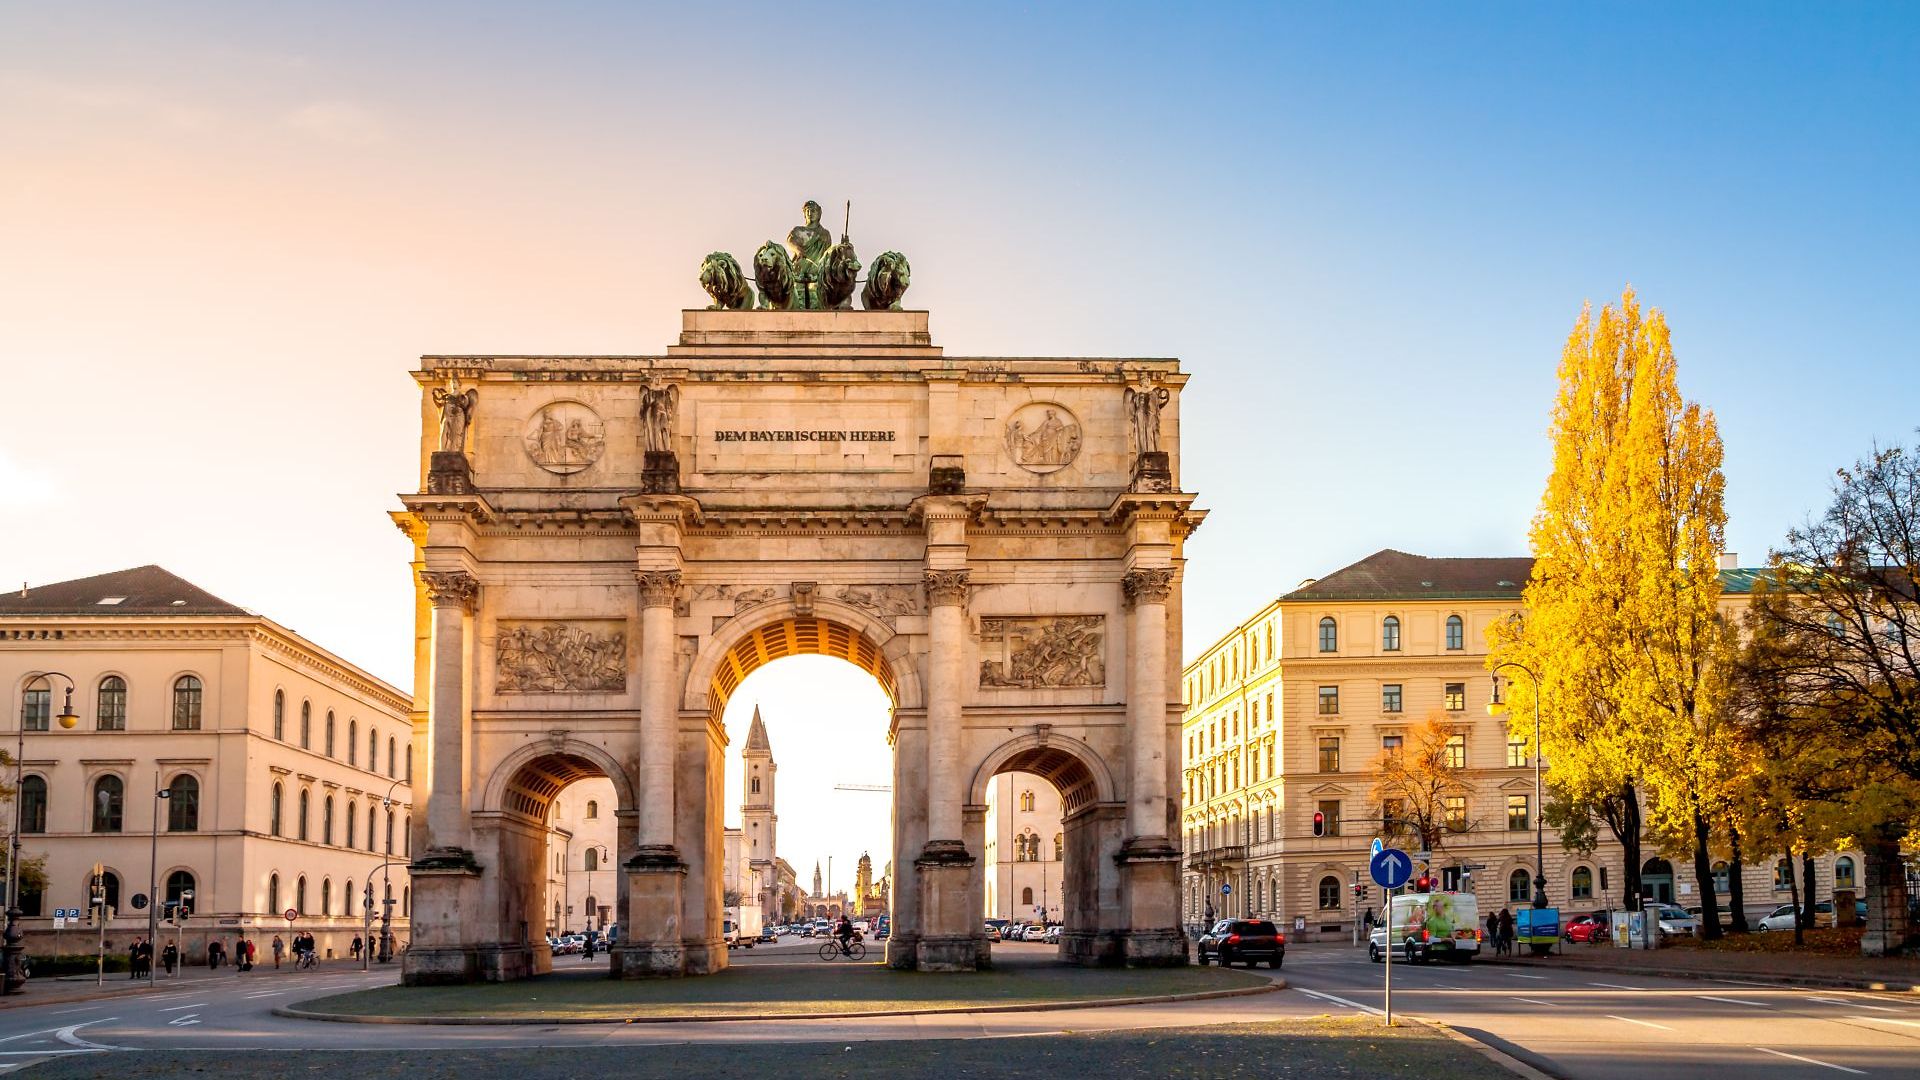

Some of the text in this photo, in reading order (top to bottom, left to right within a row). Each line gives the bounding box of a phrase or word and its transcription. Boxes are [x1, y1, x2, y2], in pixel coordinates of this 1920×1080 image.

[714, 430, 896, 442] DEM BAYERISCHEN HEERE
